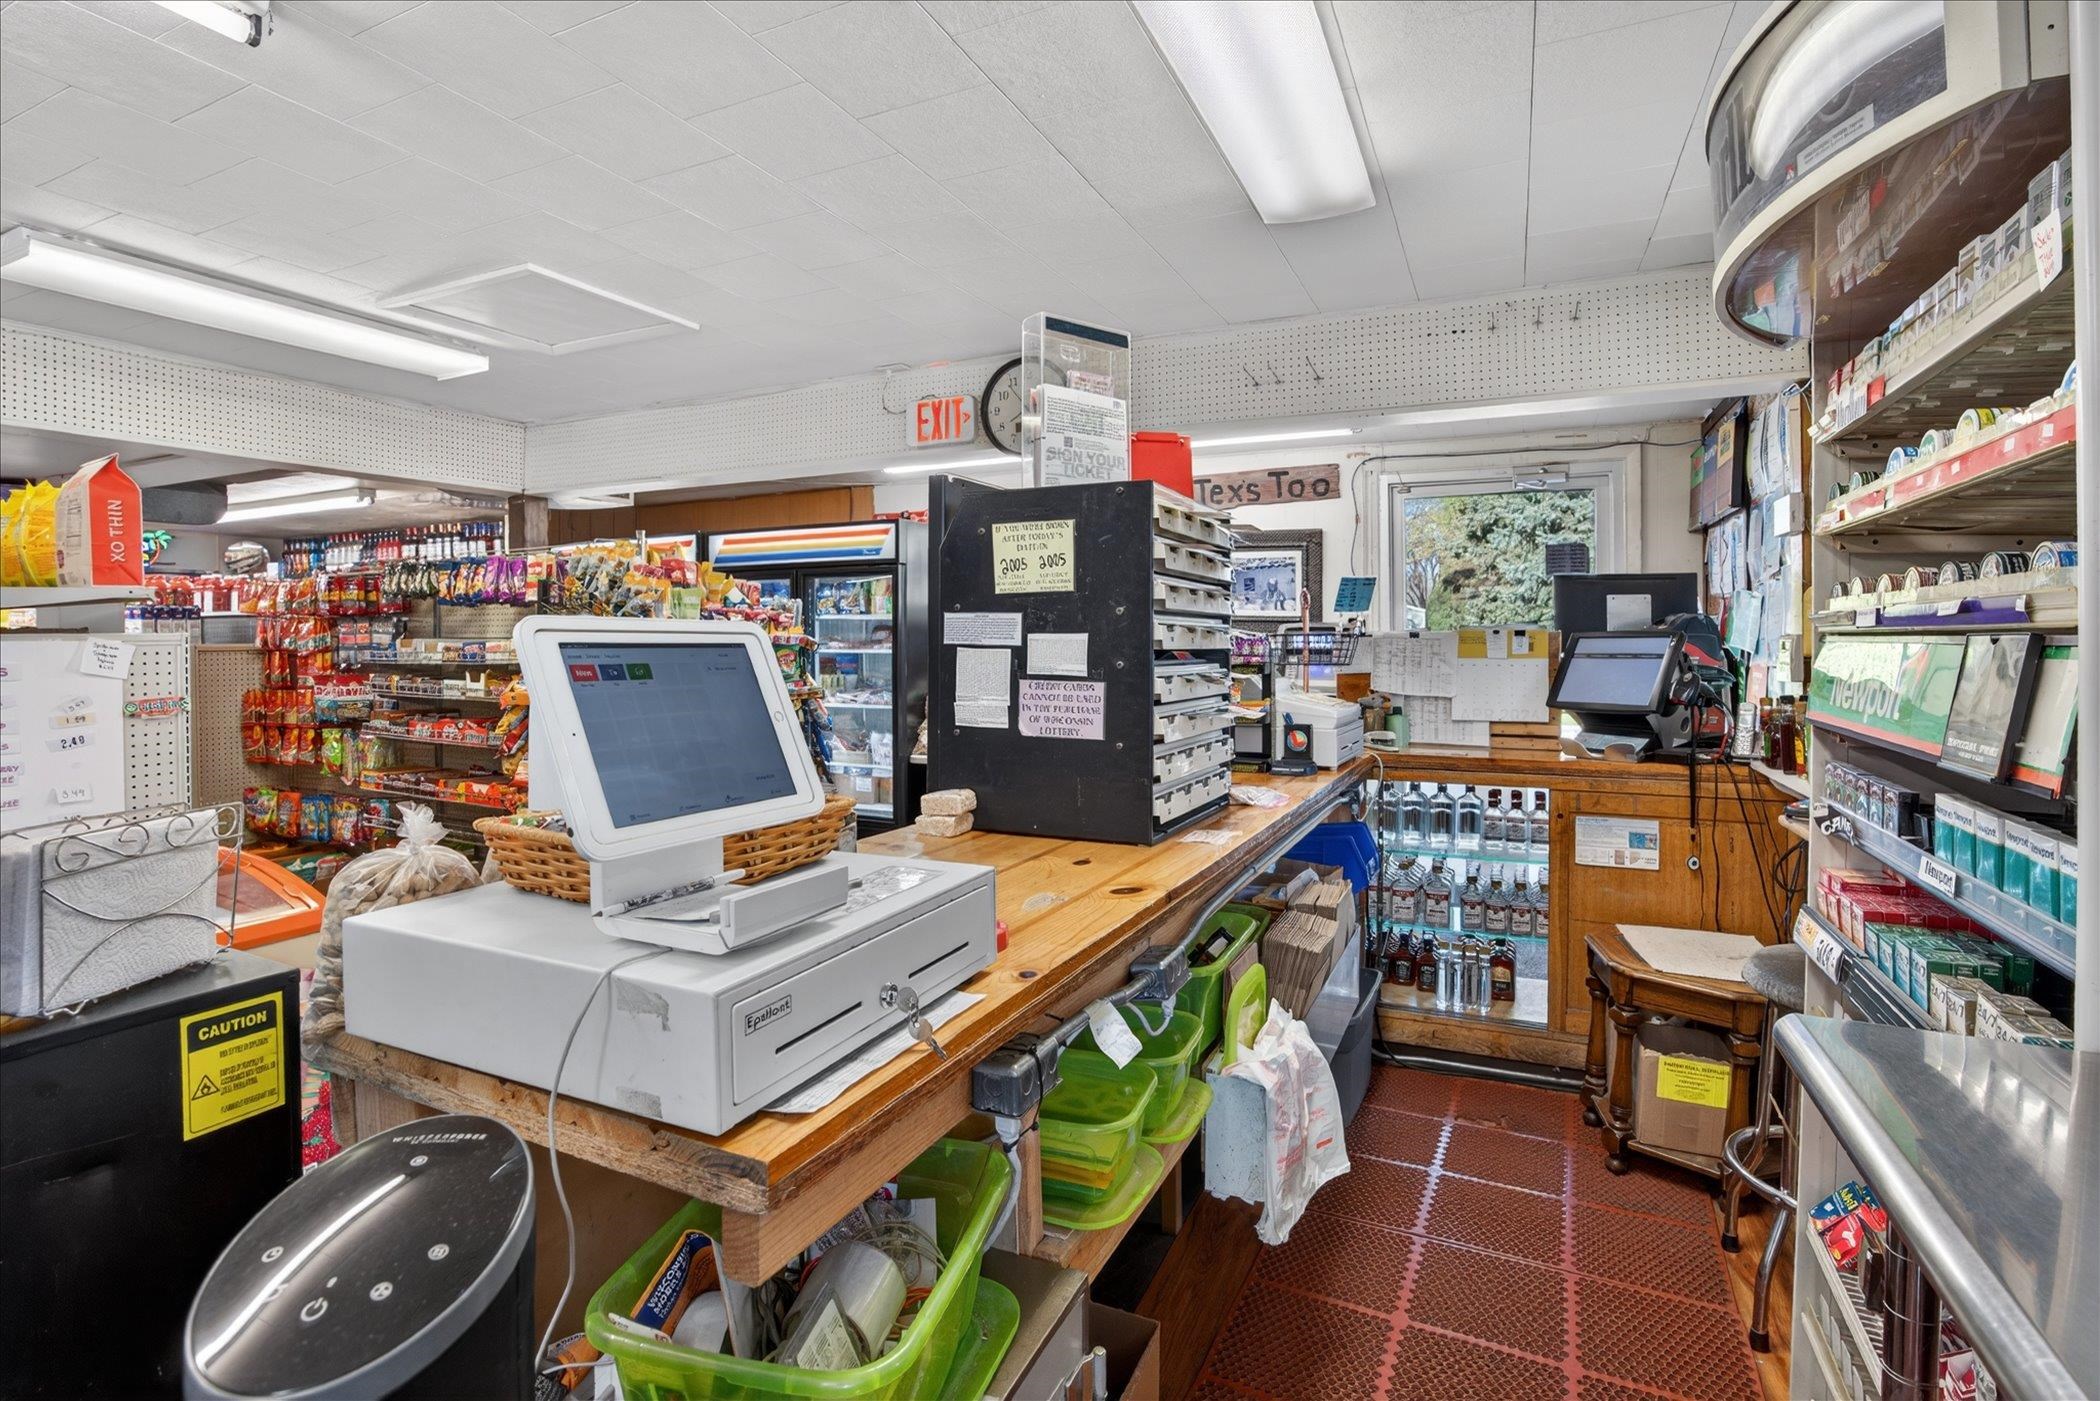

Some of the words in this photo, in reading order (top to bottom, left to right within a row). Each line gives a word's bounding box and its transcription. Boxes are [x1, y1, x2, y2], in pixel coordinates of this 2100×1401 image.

[999, 390, 1009, 401] 10
[917, 396, 964, 442] EXIT
[1045, 446, 1083, 463] SIGN
[1087, 451, 1126, 470] YOUR
[1063, 462, 1116, 480] TICKET
[1194, 477, 1242, 505] Tex's
[1267, 470, 1330, 499] Too
[107, 499, 124, 538] THIN
[1829, 677, 1901, 724] Newport
[198, 1010, 267, 1041] CAUTION
